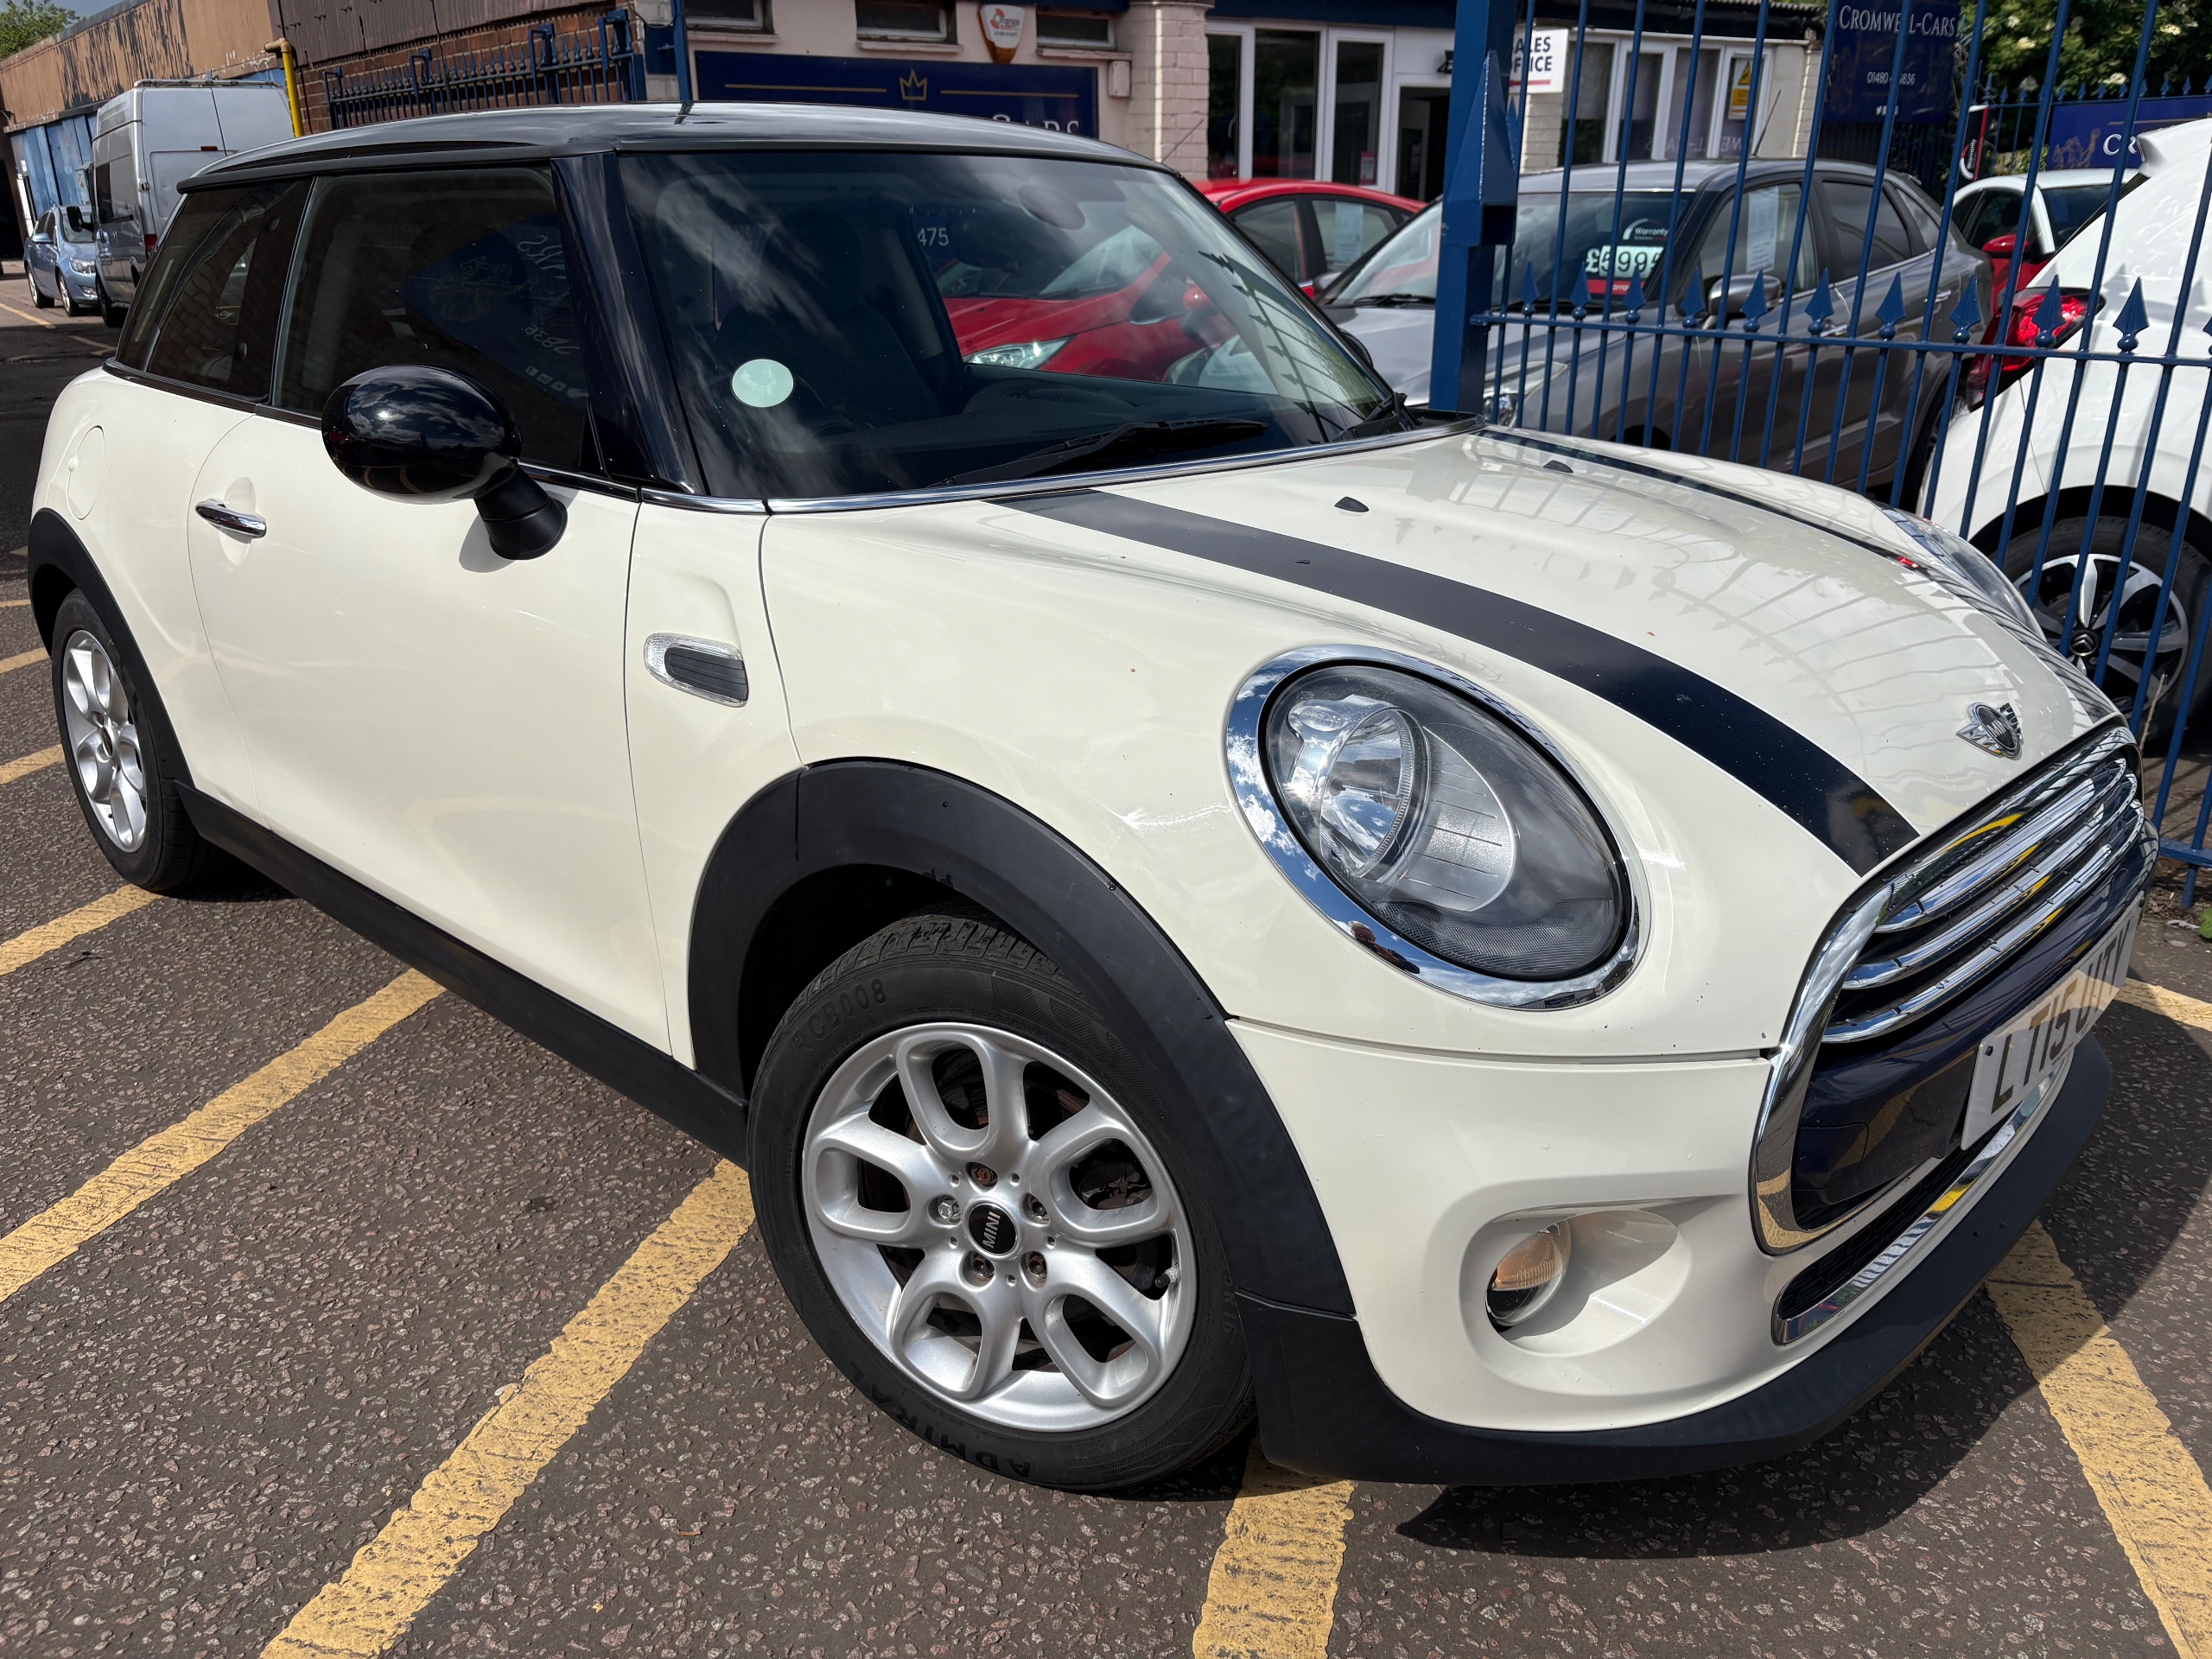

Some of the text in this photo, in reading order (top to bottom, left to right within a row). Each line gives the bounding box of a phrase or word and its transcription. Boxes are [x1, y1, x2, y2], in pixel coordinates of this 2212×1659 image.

[1839, 5, 1955, 37] CROMWEL-CARS
[1991, 977, 2079, 1115] LT15
[982, 1211, 1001, 1249] MINI
[849, 1362, 1032, 1478] ADMIRAL
